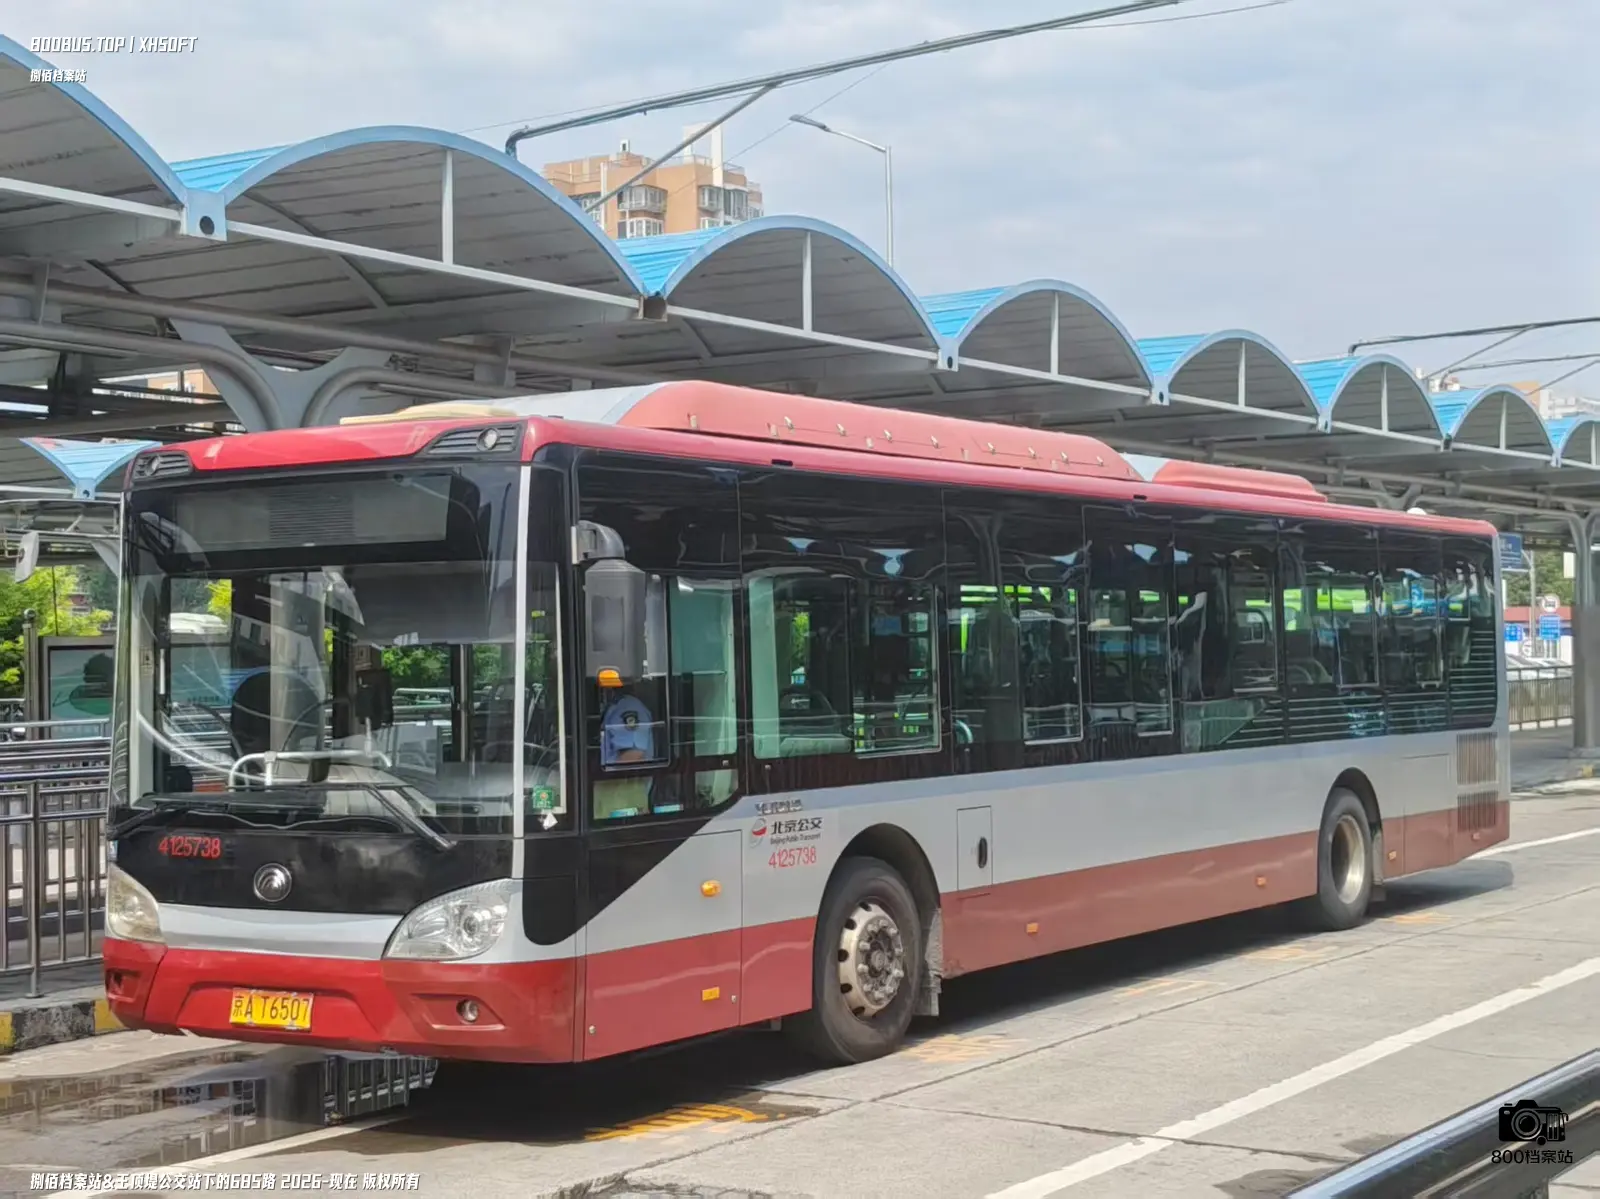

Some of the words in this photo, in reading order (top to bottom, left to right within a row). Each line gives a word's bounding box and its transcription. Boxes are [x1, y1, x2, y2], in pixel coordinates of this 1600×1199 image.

[771, 817, 823, 834] 北京公交
[158, 836, 222, 858] 4125738
[768, 846, 817, 868] 4125738
